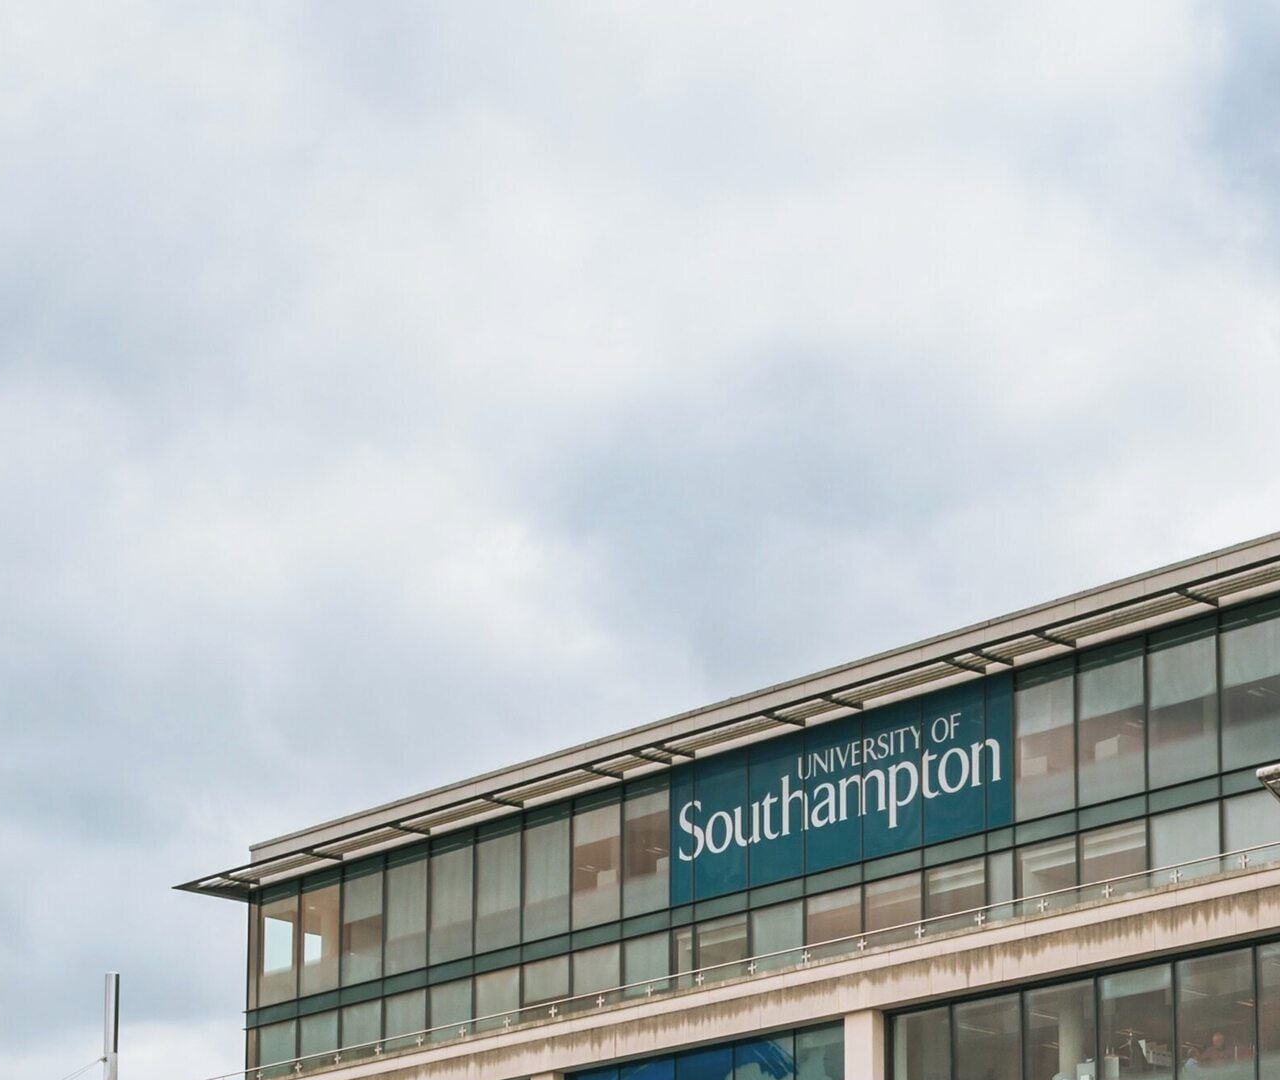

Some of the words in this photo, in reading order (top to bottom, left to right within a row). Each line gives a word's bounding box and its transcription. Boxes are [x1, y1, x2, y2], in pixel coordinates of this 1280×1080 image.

[797, 725, 921, 780] UNIVERSITY
[931, 713, 962, 744] OF
[678, 737, 1002, 862] Southampton
